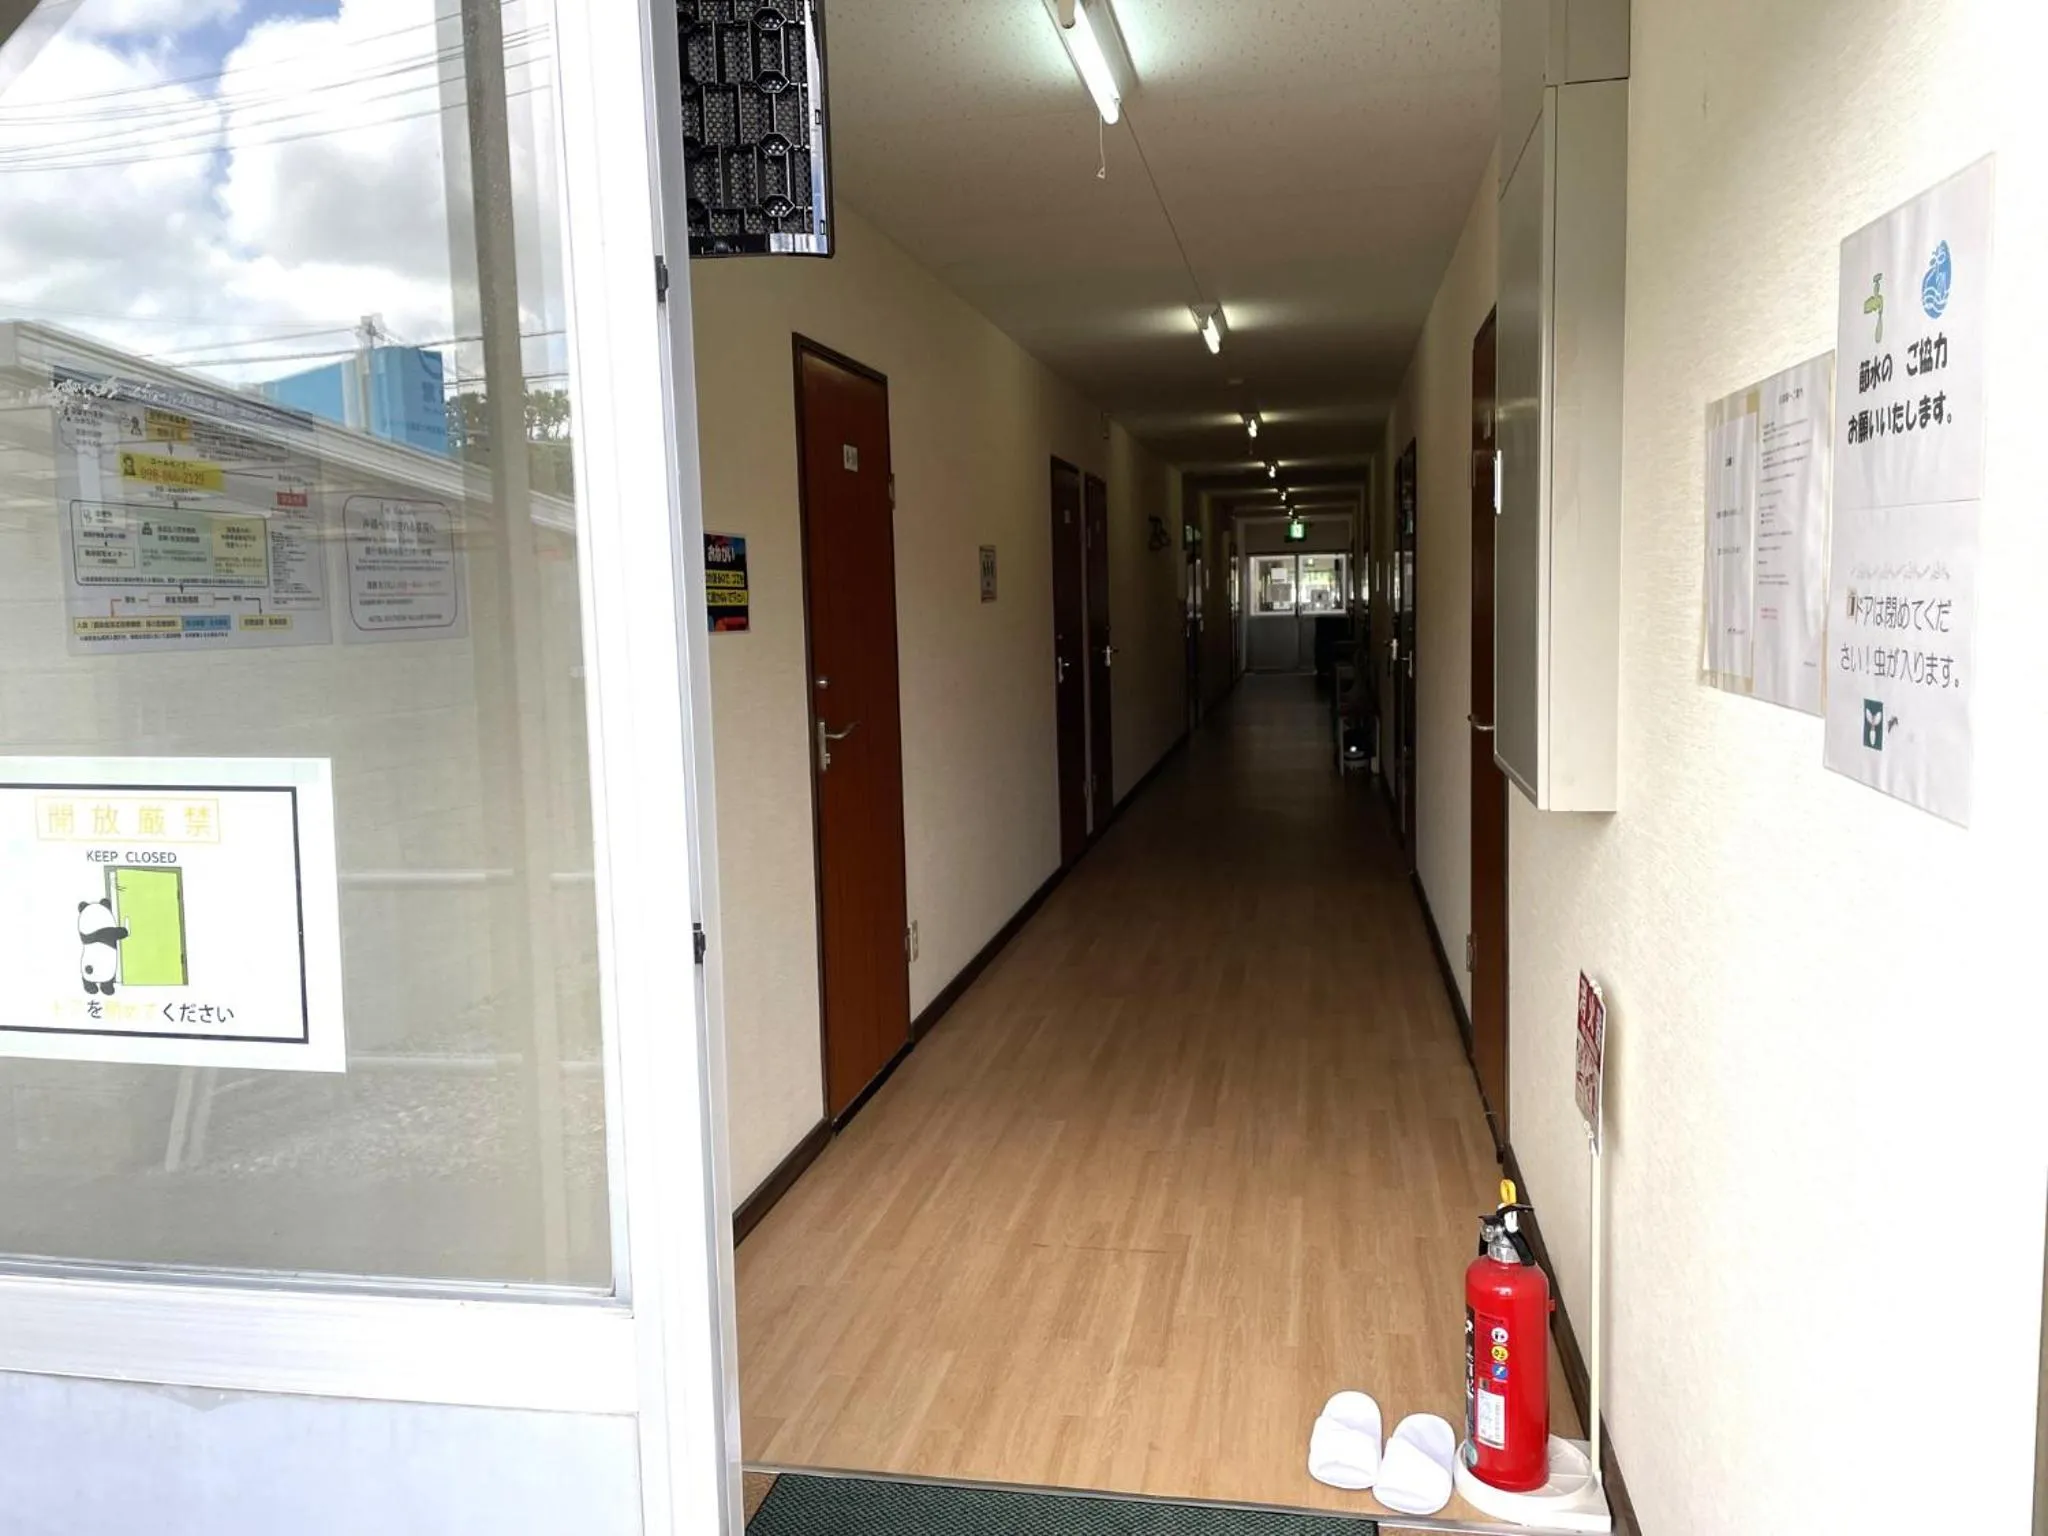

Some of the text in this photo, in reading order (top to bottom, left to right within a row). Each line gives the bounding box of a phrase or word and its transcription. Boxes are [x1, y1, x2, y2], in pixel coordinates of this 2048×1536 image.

[1858, 332, 1948, 393] 節水の ご協力
[1848, 391, 1951, 444] お願いいたします。
[1853, 595, 1952, 633] ドアは閉めてくだ
[47, 805, 212, 836] 開放厳禁
[86, 850, 177, 864] KEEP CLOSED
